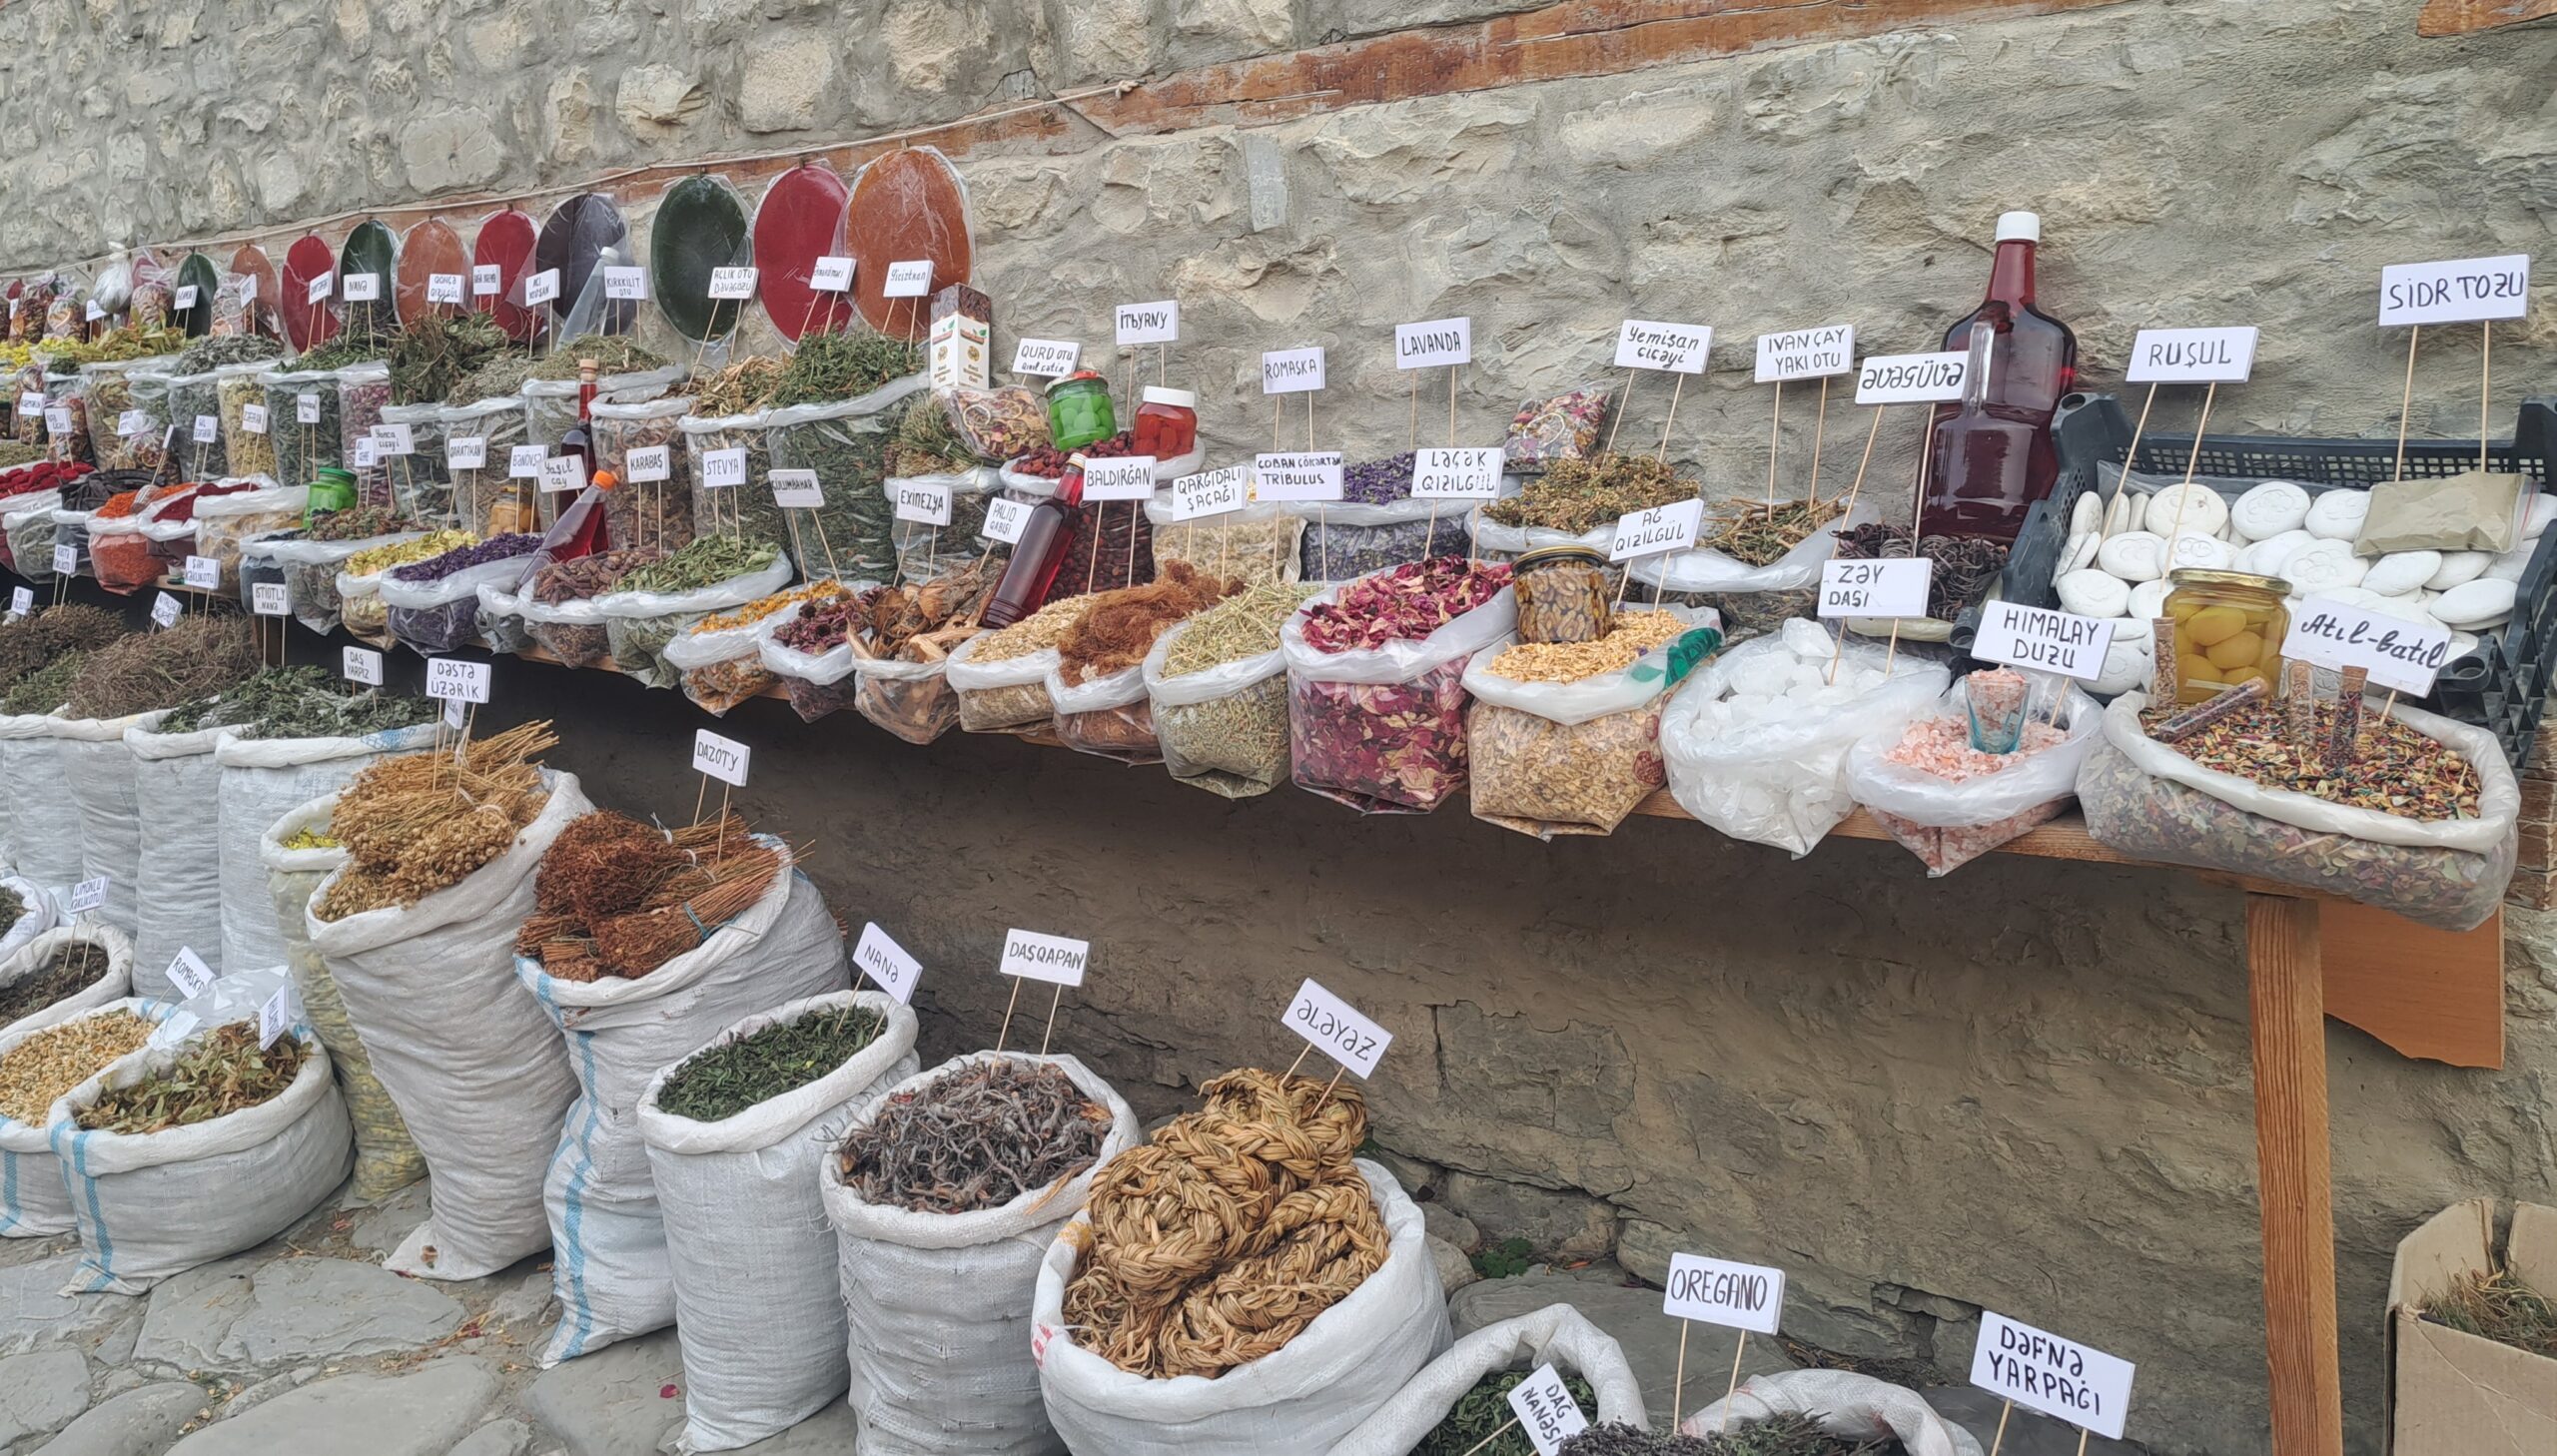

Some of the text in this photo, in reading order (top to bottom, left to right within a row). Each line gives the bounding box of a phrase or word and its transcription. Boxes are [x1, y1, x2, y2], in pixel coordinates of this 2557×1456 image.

[2387, 271, 2525, 311] SİDR TOZU
[1021, 345, 1055, 361] QURD
[1401, 332, 1461, 358] LAVANDA
[1812, 349, 1841, 369] OTU
[705, 457, 740, 477] STEVYA
[1838, 564, 1885, 584] ZƏY
[2004, 608, 2099, 646] HIMALAY
[2013, 637, 2075, 668] DUZU
[1669, 1268, 1769, 1312] OREGANO
